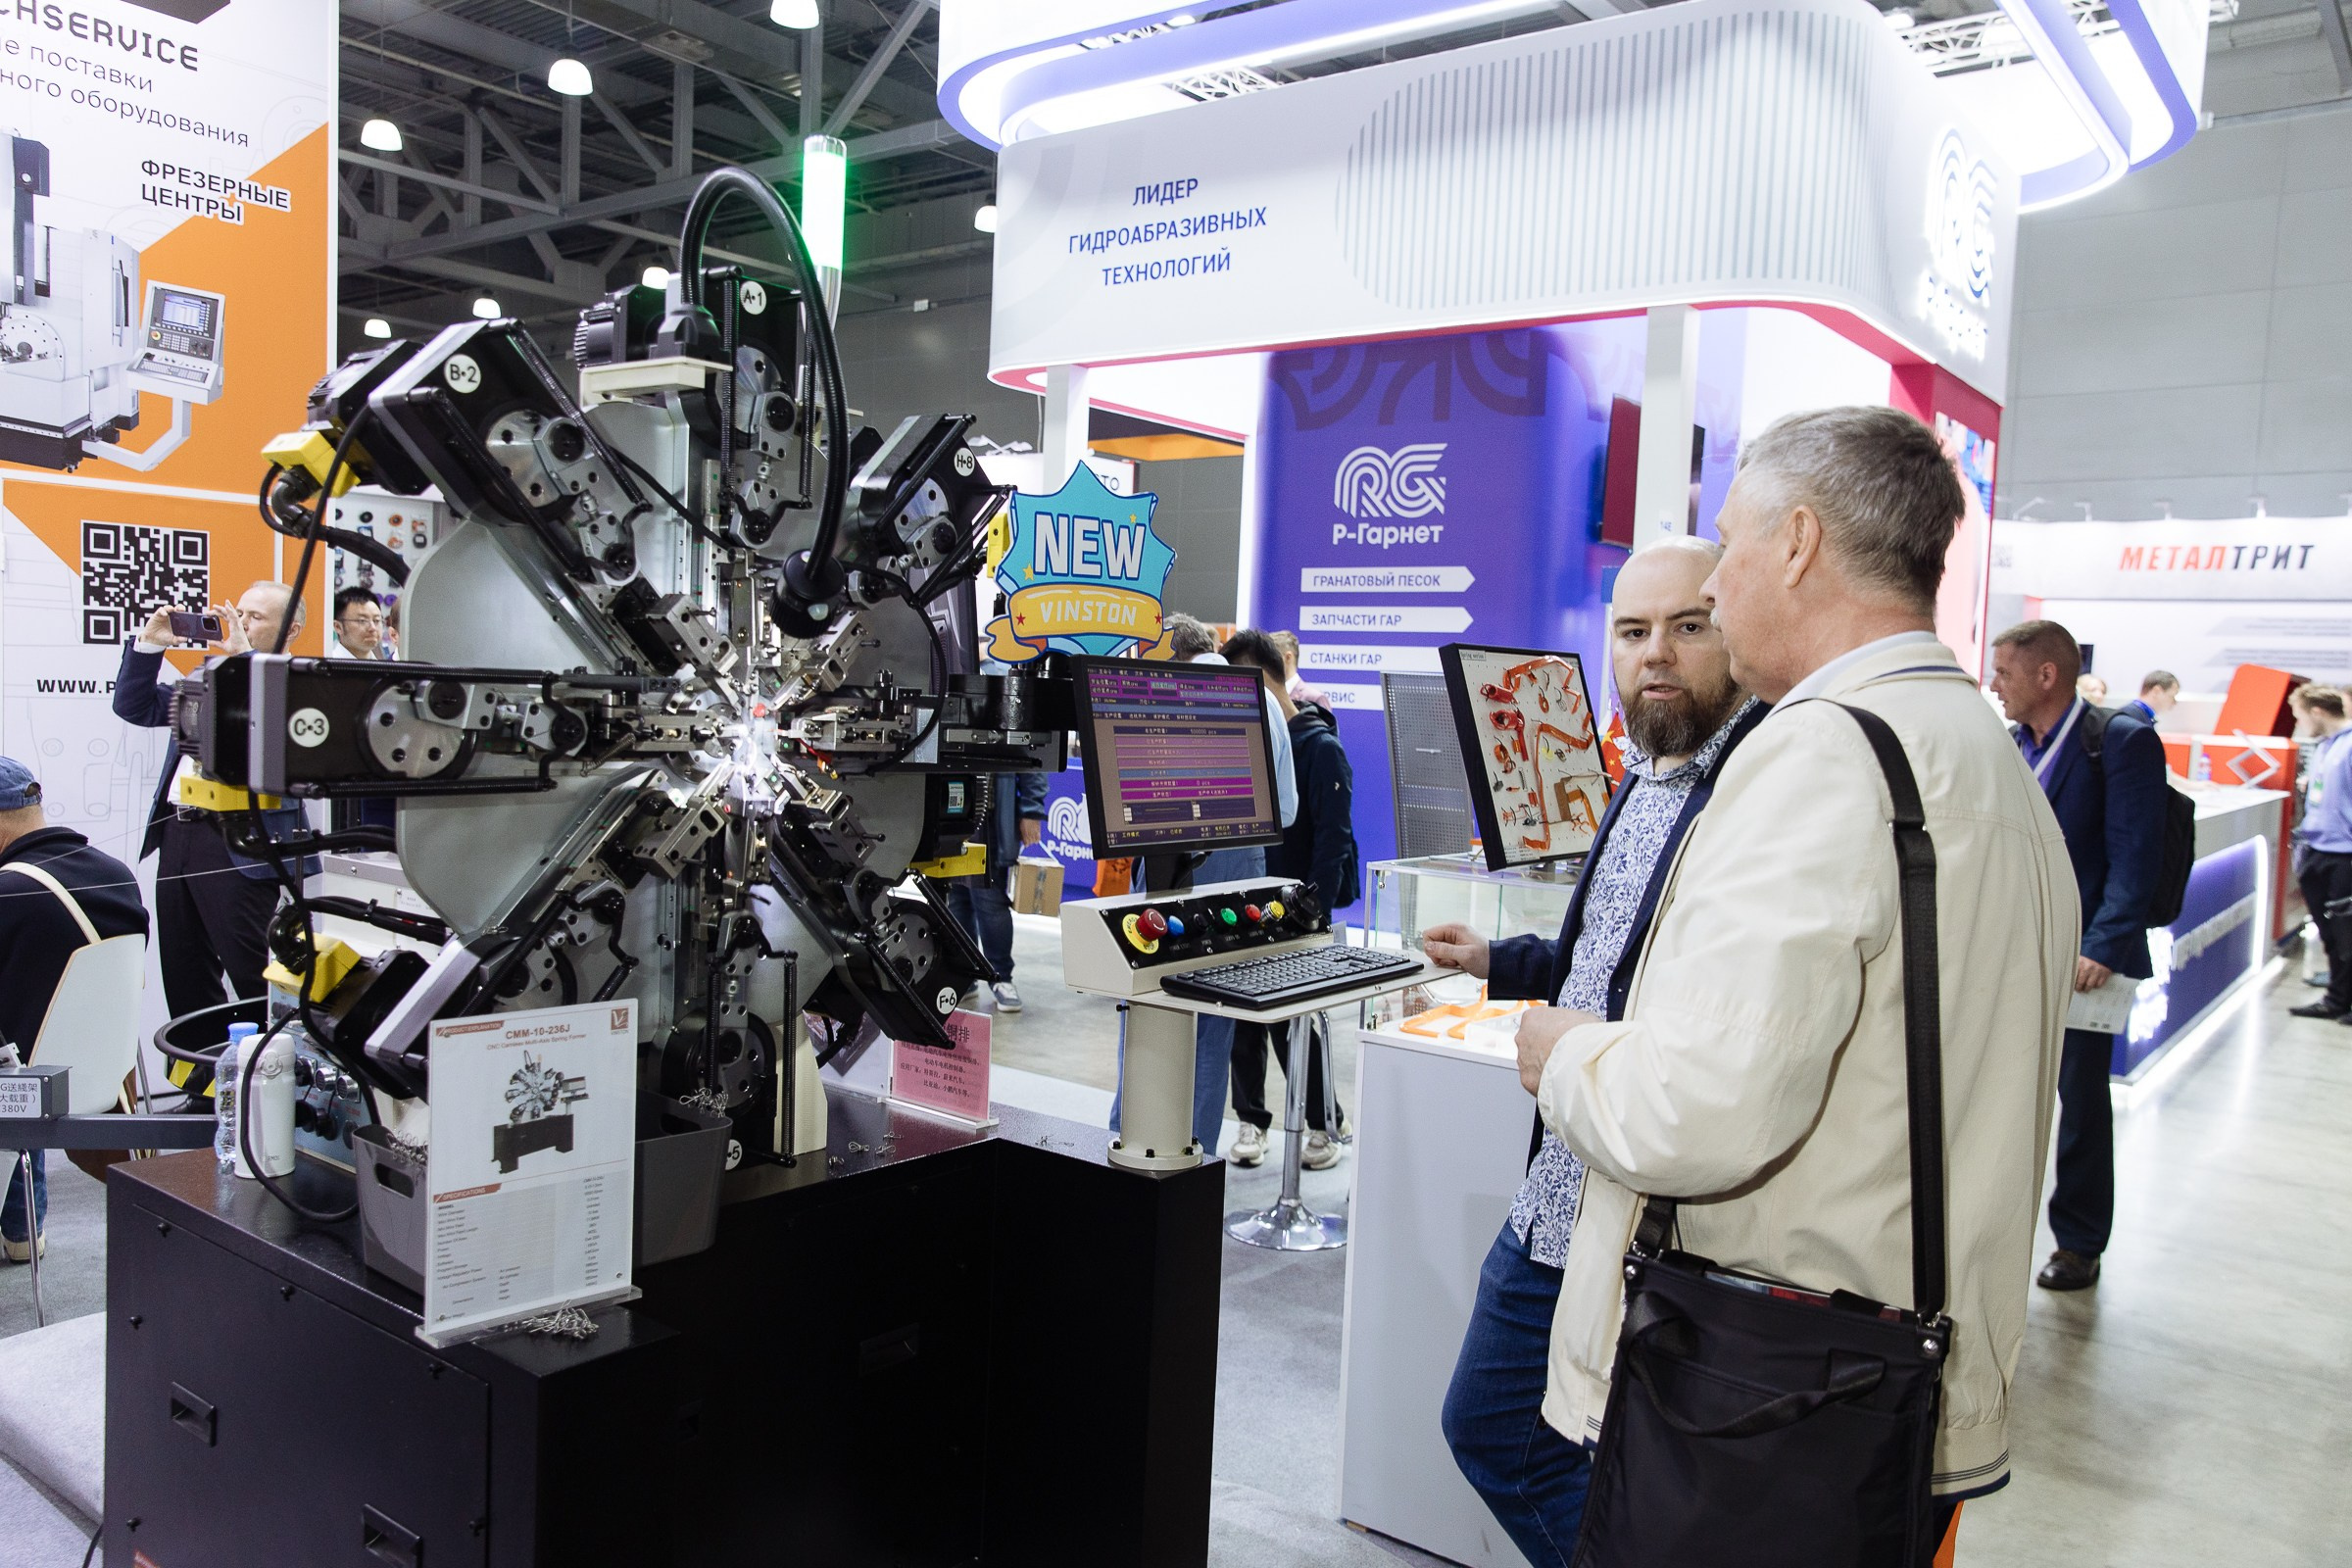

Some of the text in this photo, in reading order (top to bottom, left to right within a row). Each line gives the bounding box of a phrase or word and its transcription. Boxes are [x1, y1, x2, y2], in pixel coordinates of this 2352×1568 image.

[0, 0, 199, 72] HSERVICE
[30, 45, 153, 93] поставки
[71, 88, 249, 148] оборудования
[141, 159, 288, 209] ФРЕЗЕРНЫЕ
[1133, 178, 1199, 206] ЛИДЕР
[141, 183, 242, 221] ЦЕНТРЫ
[1069, 207, 1267, 255] ГИДРОАБРАЗИВНЫХ
[1102, 247, 1231, 286] ТЕХНОЛОГИЙ
[1334, 443, 1447, 518] RG
[1034, 511, 1147, 581] NEW
[1333, 522, 1444, 549] Р-Гарнет
[2119, 544, 2315, 570] МЕТАЛТРИТ
[1313, 572, 1441, 587] ГРАНАТОВЫЙ ПЕСОК
[1040, 601, 1137, 626] VINSTON
[1312, 613, 1401, 626] ЗАПЧАСТИ ГАР
[1310, 652, 1382, 665] СТАНКИ ГАР
[37, 679, 117, 694] WWW.P
[1323, 691, 1355, 704] РВИС
[1048, 840, 1093, 860] Р-Гарн
[506, 1024, 571, 1040] CMM-10-236J
[2, 1104, 26, 1113] 380V
